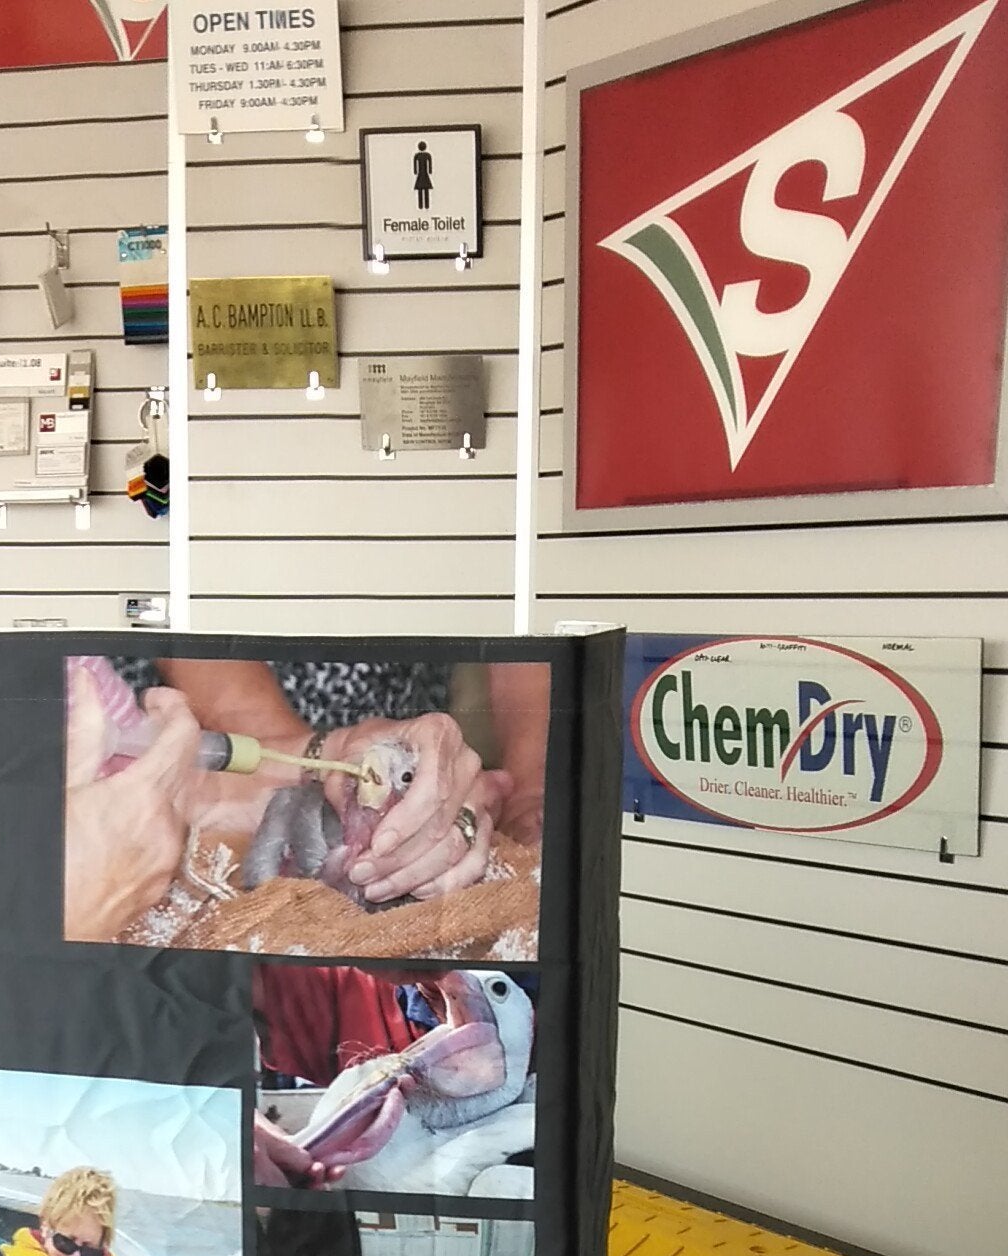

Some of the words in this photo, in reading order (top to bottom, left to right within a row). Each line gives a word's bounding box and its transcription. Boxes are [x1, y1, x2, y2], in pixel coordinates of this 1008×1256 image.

[193, 11, 249, 33] OPEN
[190, 43, 235, 55] MONDAY
[190, 63, 217, 74] TUES
[226, 61, 249, 72] WED
[189, 80, 244, 92] THURSDAY
[198, 98, 236, 110] FRIDAY
[383, 217, 429, 232] Female
[431, 216, 465, 231] Toilet
[228, 302, 294, 328] BAMPTON
[699, 777, 732, 795] Drier.
[734, 780, 783, 800] Cleaner.
